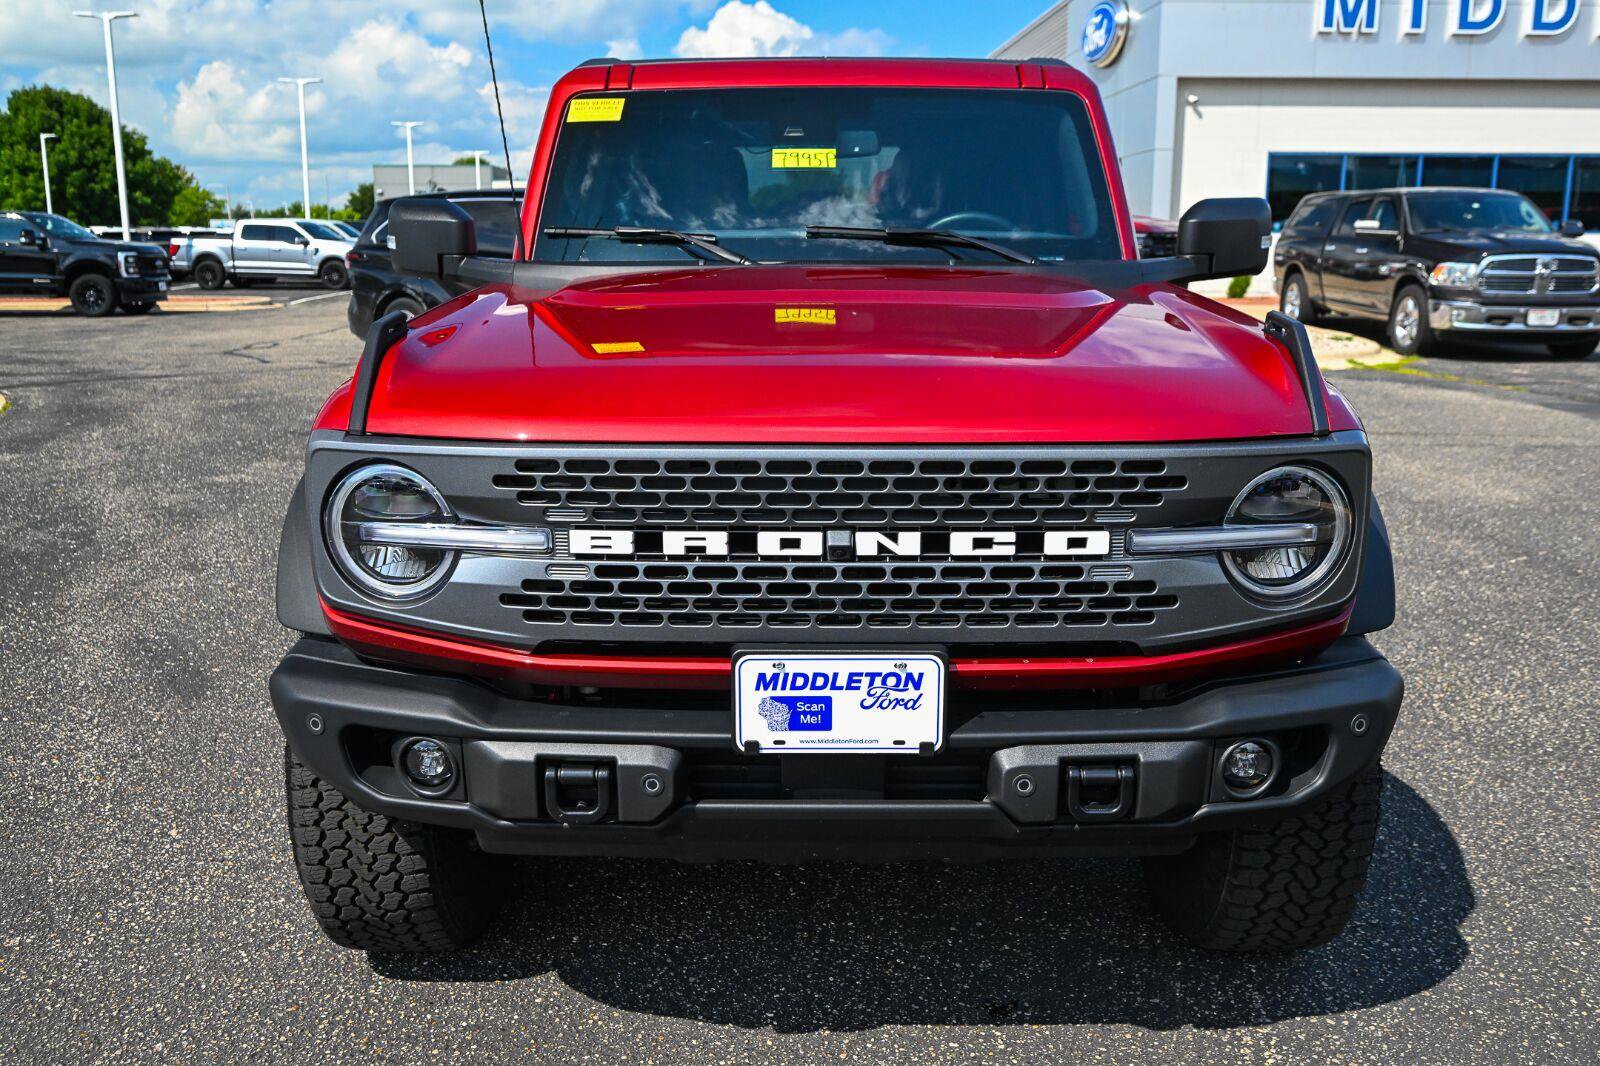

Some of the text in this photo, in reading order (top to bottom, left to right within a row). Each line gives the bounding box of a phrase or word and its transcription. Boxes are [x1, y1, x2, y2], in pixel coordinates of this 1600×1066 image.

[568, 529, 1111, 556] BRONCO
[754, 671, 925, 692] MIDDLETON
[796, 701, 825, 712] Scan
[859, 686, 924, 711] Ford
[800, 714, 822, 724] Me!
